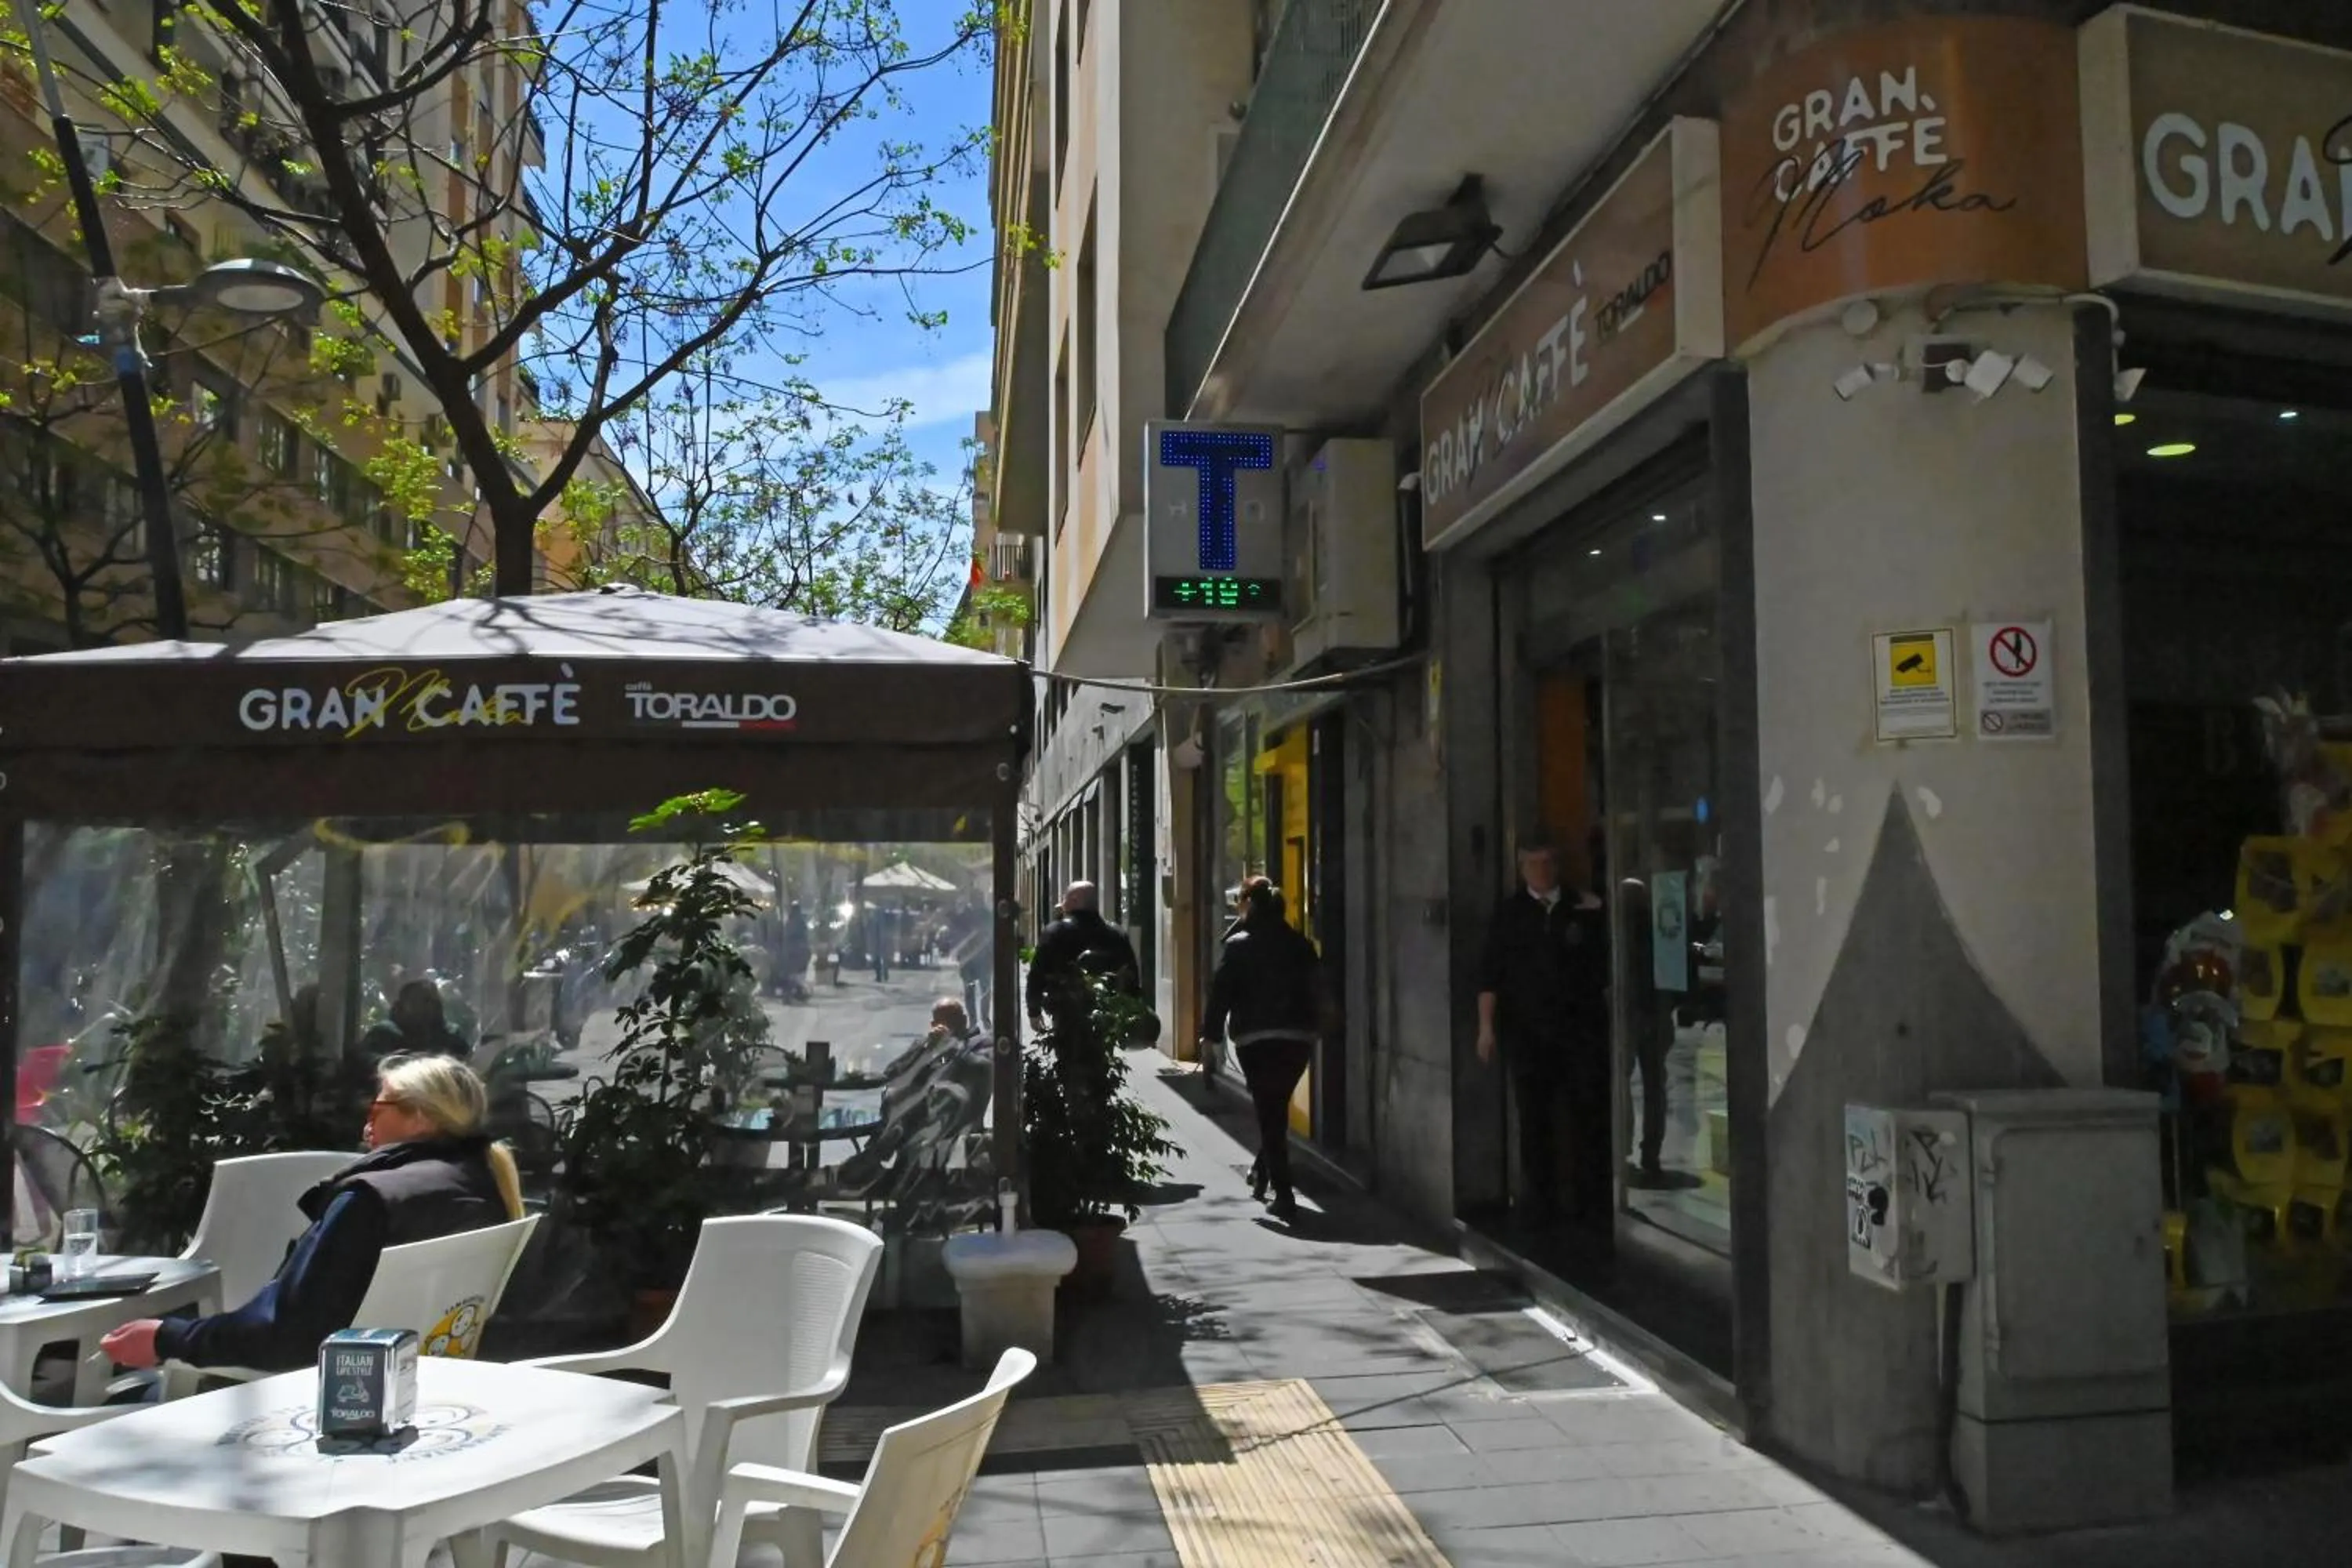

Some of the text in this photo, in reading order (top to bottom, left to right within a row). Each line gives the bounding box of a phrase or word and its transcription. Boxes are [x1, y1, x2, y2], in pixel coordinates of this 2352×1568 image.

[1773, 66, 1917, 152] GRAN
[2143, 112, 2352, 242] GRA
[1425, 396, 1483, 505] GRAN
[1160, 431, 1273, 571] T
[239, 662, 582, 731] GRAN CAFFÈ
[625, 692, 797, 721] TORALDO
[336, 1354, 374, 1366] ITALIAN
[331, 1407, 376, 1419] TORALDO
